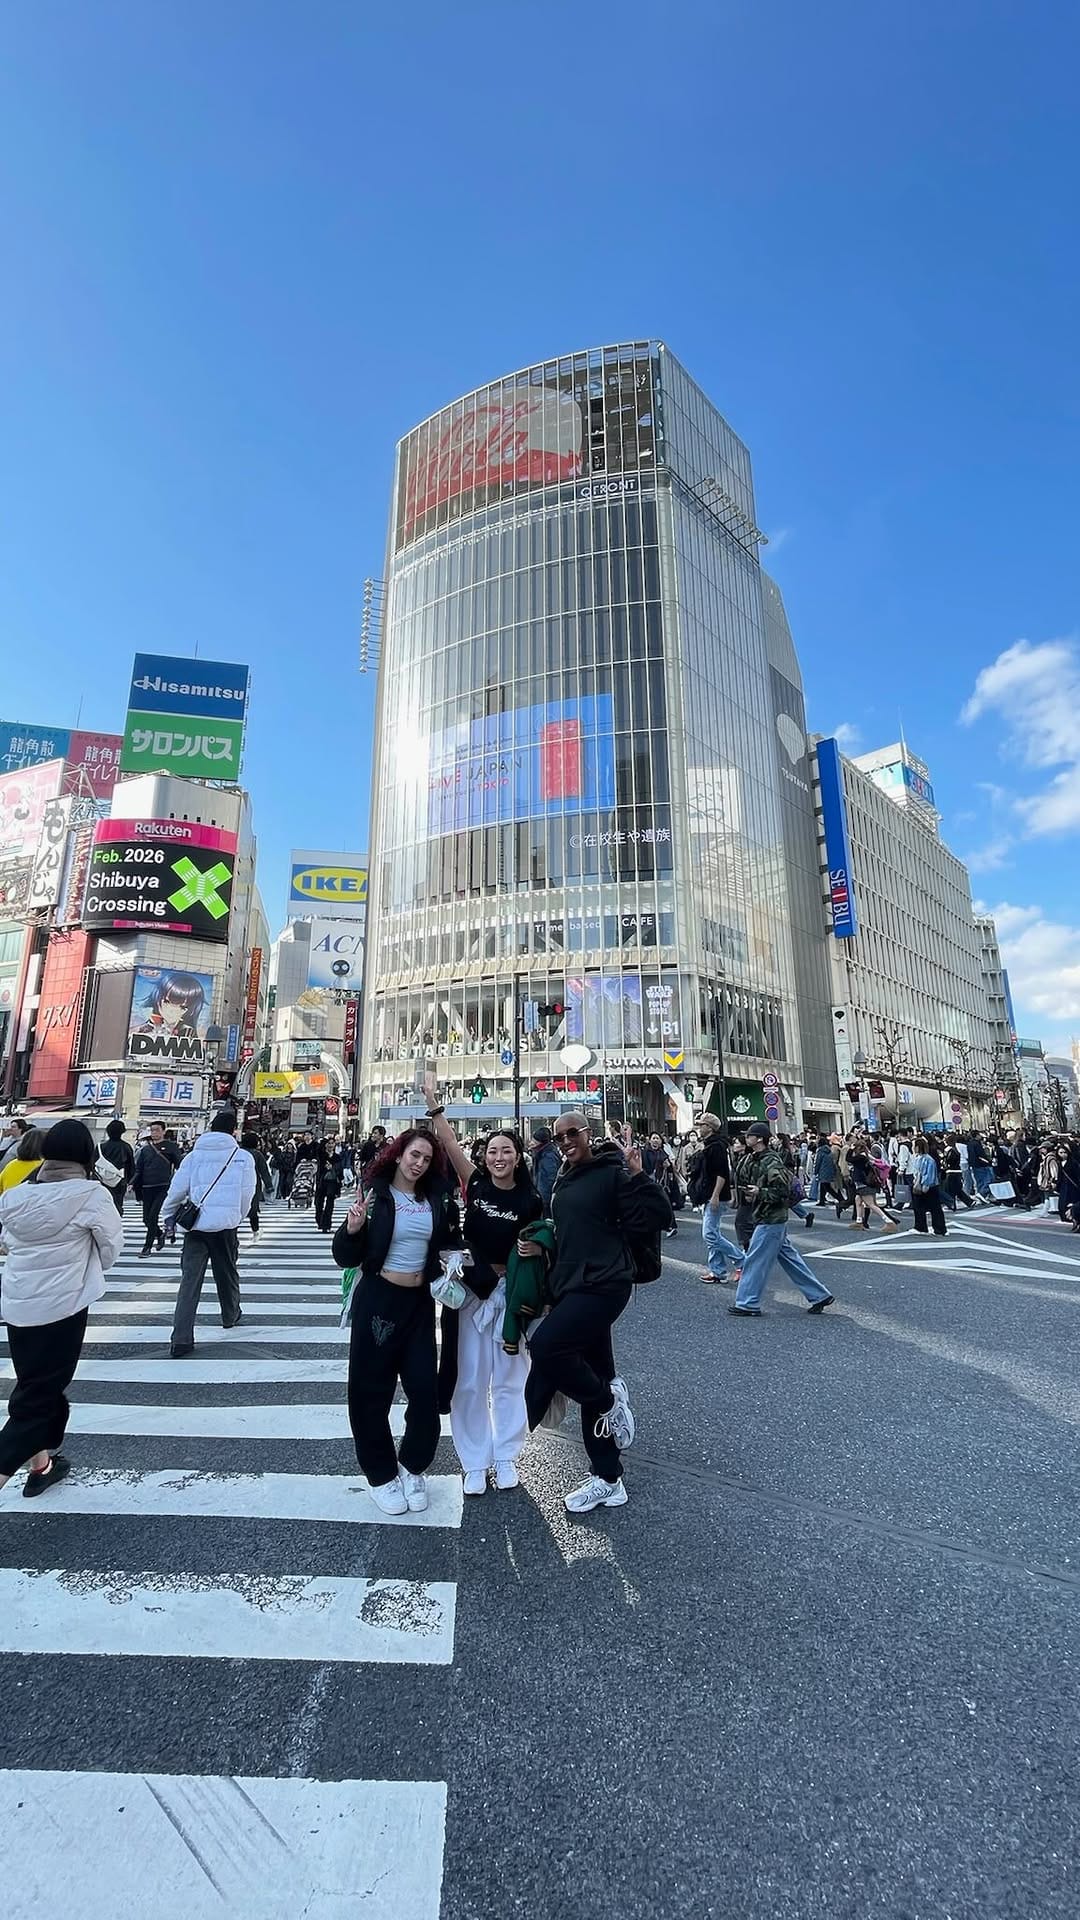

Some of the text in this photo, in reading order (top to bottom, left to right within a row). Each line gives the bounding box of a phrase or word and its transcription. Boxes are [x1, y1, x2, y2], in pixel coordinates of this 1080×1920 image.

[580, 478, 635, 498] QFRONT
[133, 675, 245, 700] Hisamitsu
[10, 737, 55, 756] 龍角散
[131, 728, 233, 762] サロンパス
[466, 756, 522, 781] JAPAN
[134, 822, 191, 838] Rakuten
[32, 800, 65, 902] もんじゃ
[90, 871, 159, 890] Shibuya
[87, 896, 167, 916] Crossing
[830, 868, 850, 925] SEIBU
[622, 916, 653, 927] CAFE
[346, 1006, 355, 1047] カラオケ
[662, 1020, 680, 1036] B1
[130, 1033, 203, 1059] DMM
[398, 1037, 528, 1060] STARBUCKS
[599, 1056, 656, 1067] TSUTAYA
[148, 1079, 194, 1100] 書店
